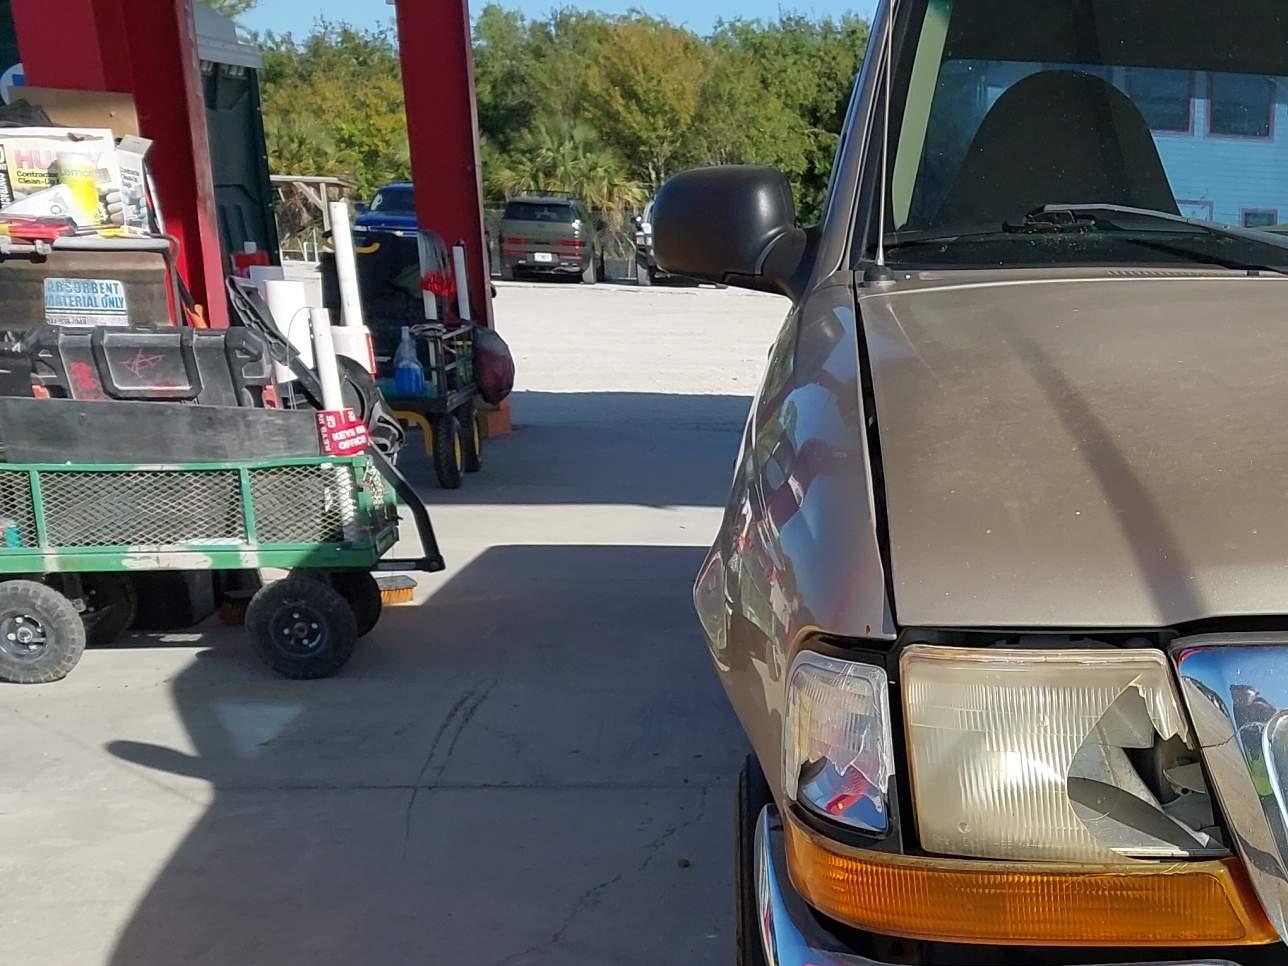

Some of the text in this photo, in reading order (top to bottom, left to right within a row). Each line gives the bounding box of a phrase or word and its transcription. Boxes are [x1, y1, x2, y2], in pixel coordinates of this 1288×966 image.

[47, 281, 119, 294] ABSORBENT
[46, 295, 124, 308] MATERIAL ONLY
